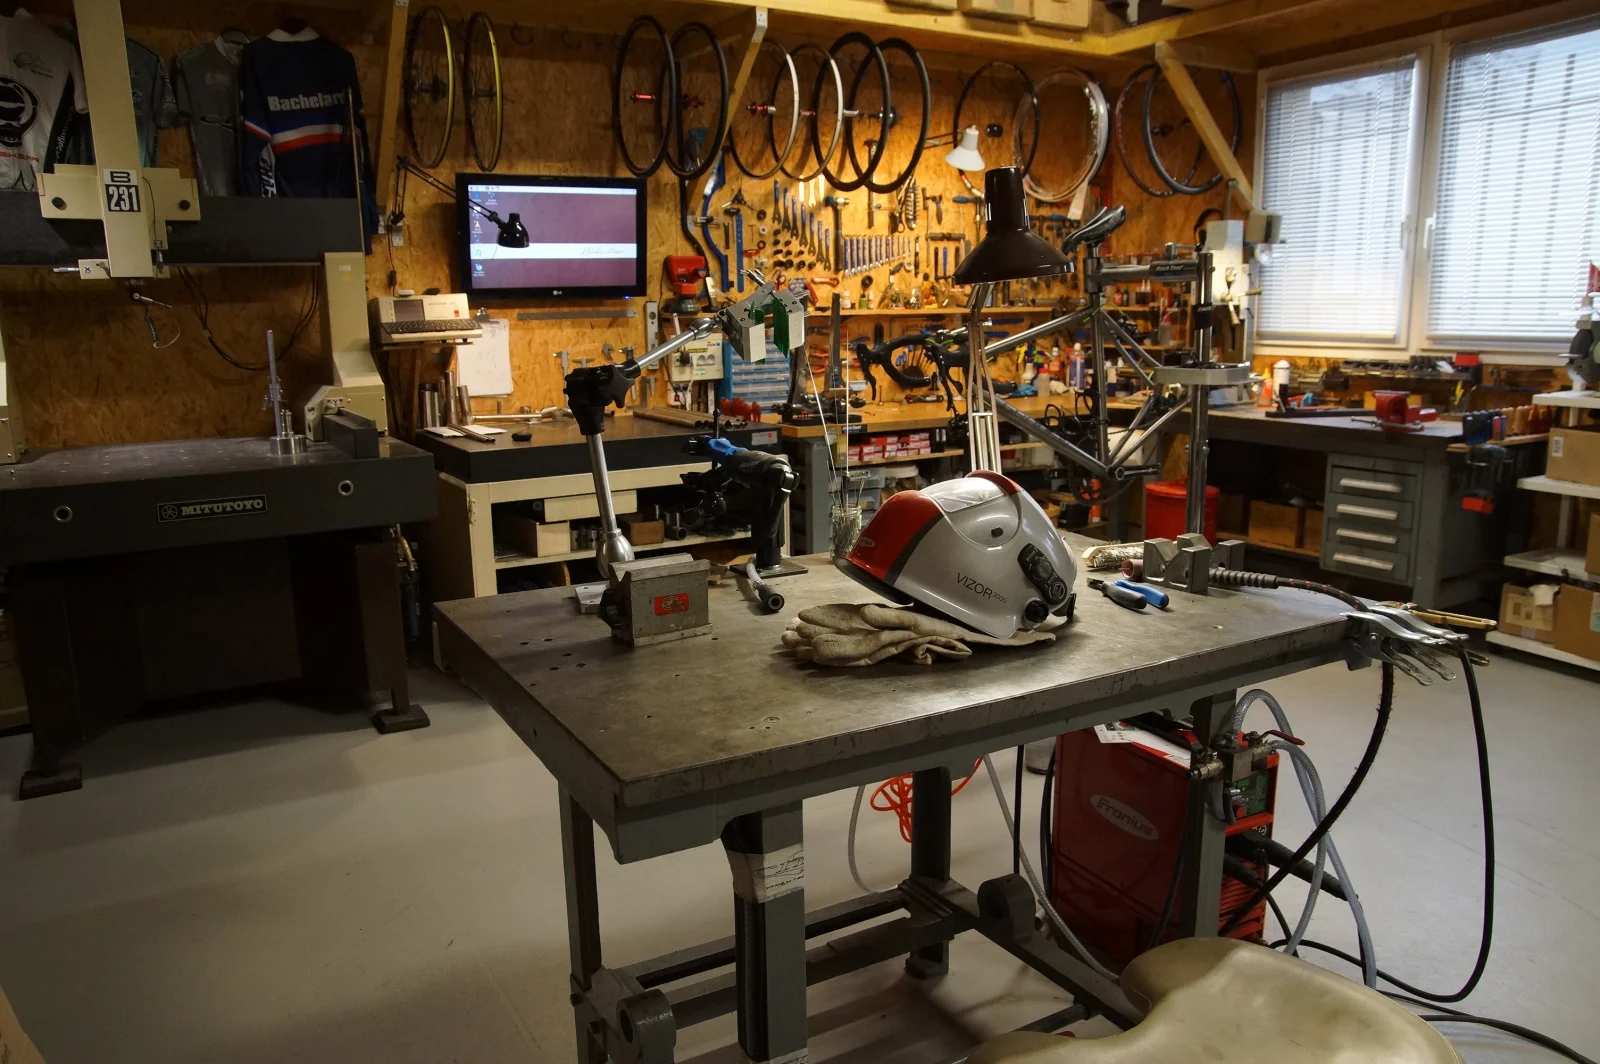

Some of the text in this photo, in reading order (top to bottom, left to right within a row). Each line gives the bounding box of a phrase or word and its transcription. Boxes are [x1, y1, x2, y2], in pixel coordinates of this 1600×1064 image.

[109, 171, 132, 184] B
[108, 186, 139, 212] 231
[180, 499, 264, 516] MITUTOYO
[957, 572, 1007, 604] VIZOR 3000
[1096, 797, 1154, 836] Fronius
